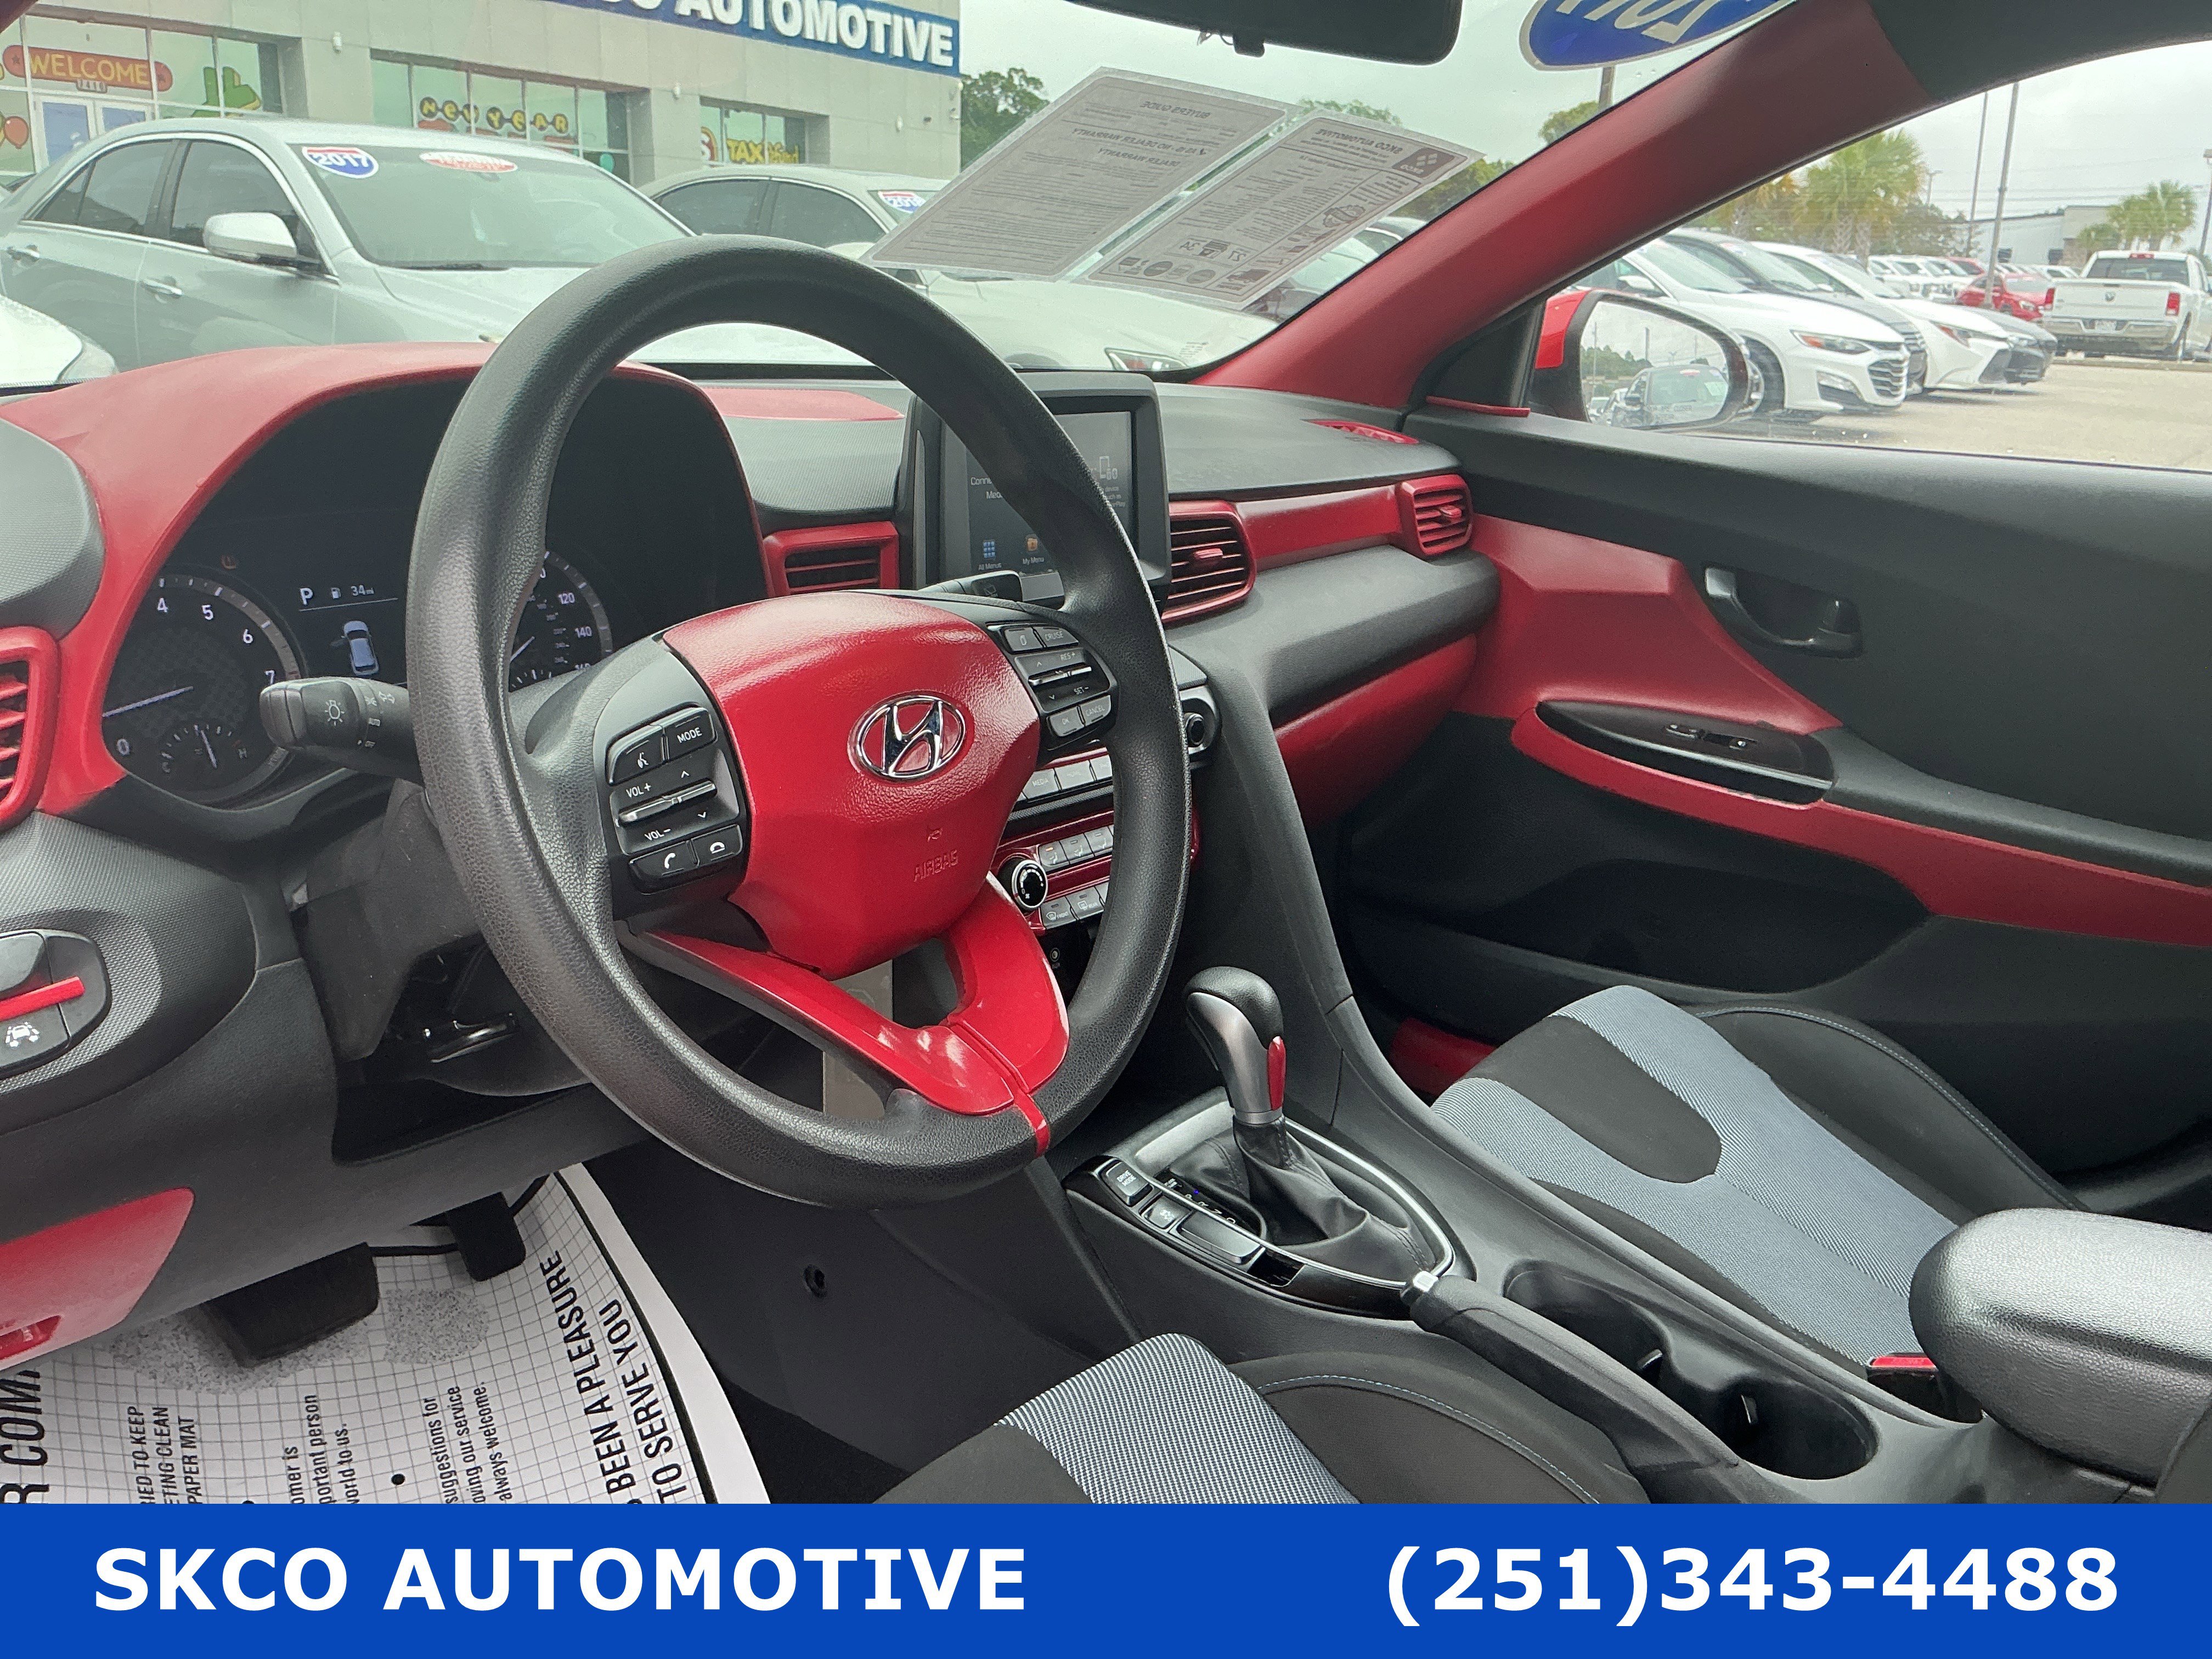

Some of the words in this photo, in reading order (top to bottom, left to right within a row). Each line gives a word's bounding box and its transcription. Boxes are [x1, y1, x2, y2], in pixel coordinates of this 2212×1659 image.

[30, 53, 149, 84] WELCOME
[313, 153, 370, 168] 2017
[726, 139, 765, 163] TAX
[157, 597, 169, 613] 4
[300, 588, 313, 606] P
[558, 592, 575, 605] 120
[202, 604, 214, 620] 5
[243, 628, 253, 644] 6
[575, 627, 592, 639] 140
[1045, 631, 1064, 641] CRUISE
[264, 669, 275, 685] 7
[1085, 704, 1106, 717] CANCEL
[676, 727, 703, 743] MODE
[116, 738, 130, 756] 0
[1031, 777, 1050, 787] MEDIA
[1116, 1170, 1132, 1182] DRIVE
[1121, 1175, 1137, 1187] MODE
[539, 1250, 606, 1394] PLEASURE
[598, 1298, 639, 1366] YOU
[422, 1397, 439, 1418] for
[447, 1386, 470, 1436] service
[473, 1381, 500, 1449] welcome.
[584, 1393, 614, 1415] A
[621, 1362, 675, 1459] SERVE
[127, 1406, 147, 1446] KEEP
[151, 1407, 173, 1457] CLEAN
[178, 1415, 198, 1449] MAT
[304, 1395, 328, 1447] person
[335, 1423, 351, 1446] us.
[132, 1450, 150, 1470] TO
[281, 1446, 300, 1460] is
[337, 1449, 353, 1466] to
[427, 1419, 459, 1504] suggestions
[459, 1440, 476, 1463] our
[590, 1419, 637, 1495] BEEN
[182, 1454, 204, 1504] PAPER
[286, 1465, 306, 1504] omer
[309, 1450, 337, 1504] portant
[465, 1465, 487, 1504] oving
[489, 1452, 513, 1502] always
[651, 1462, 687, 1504] TO
